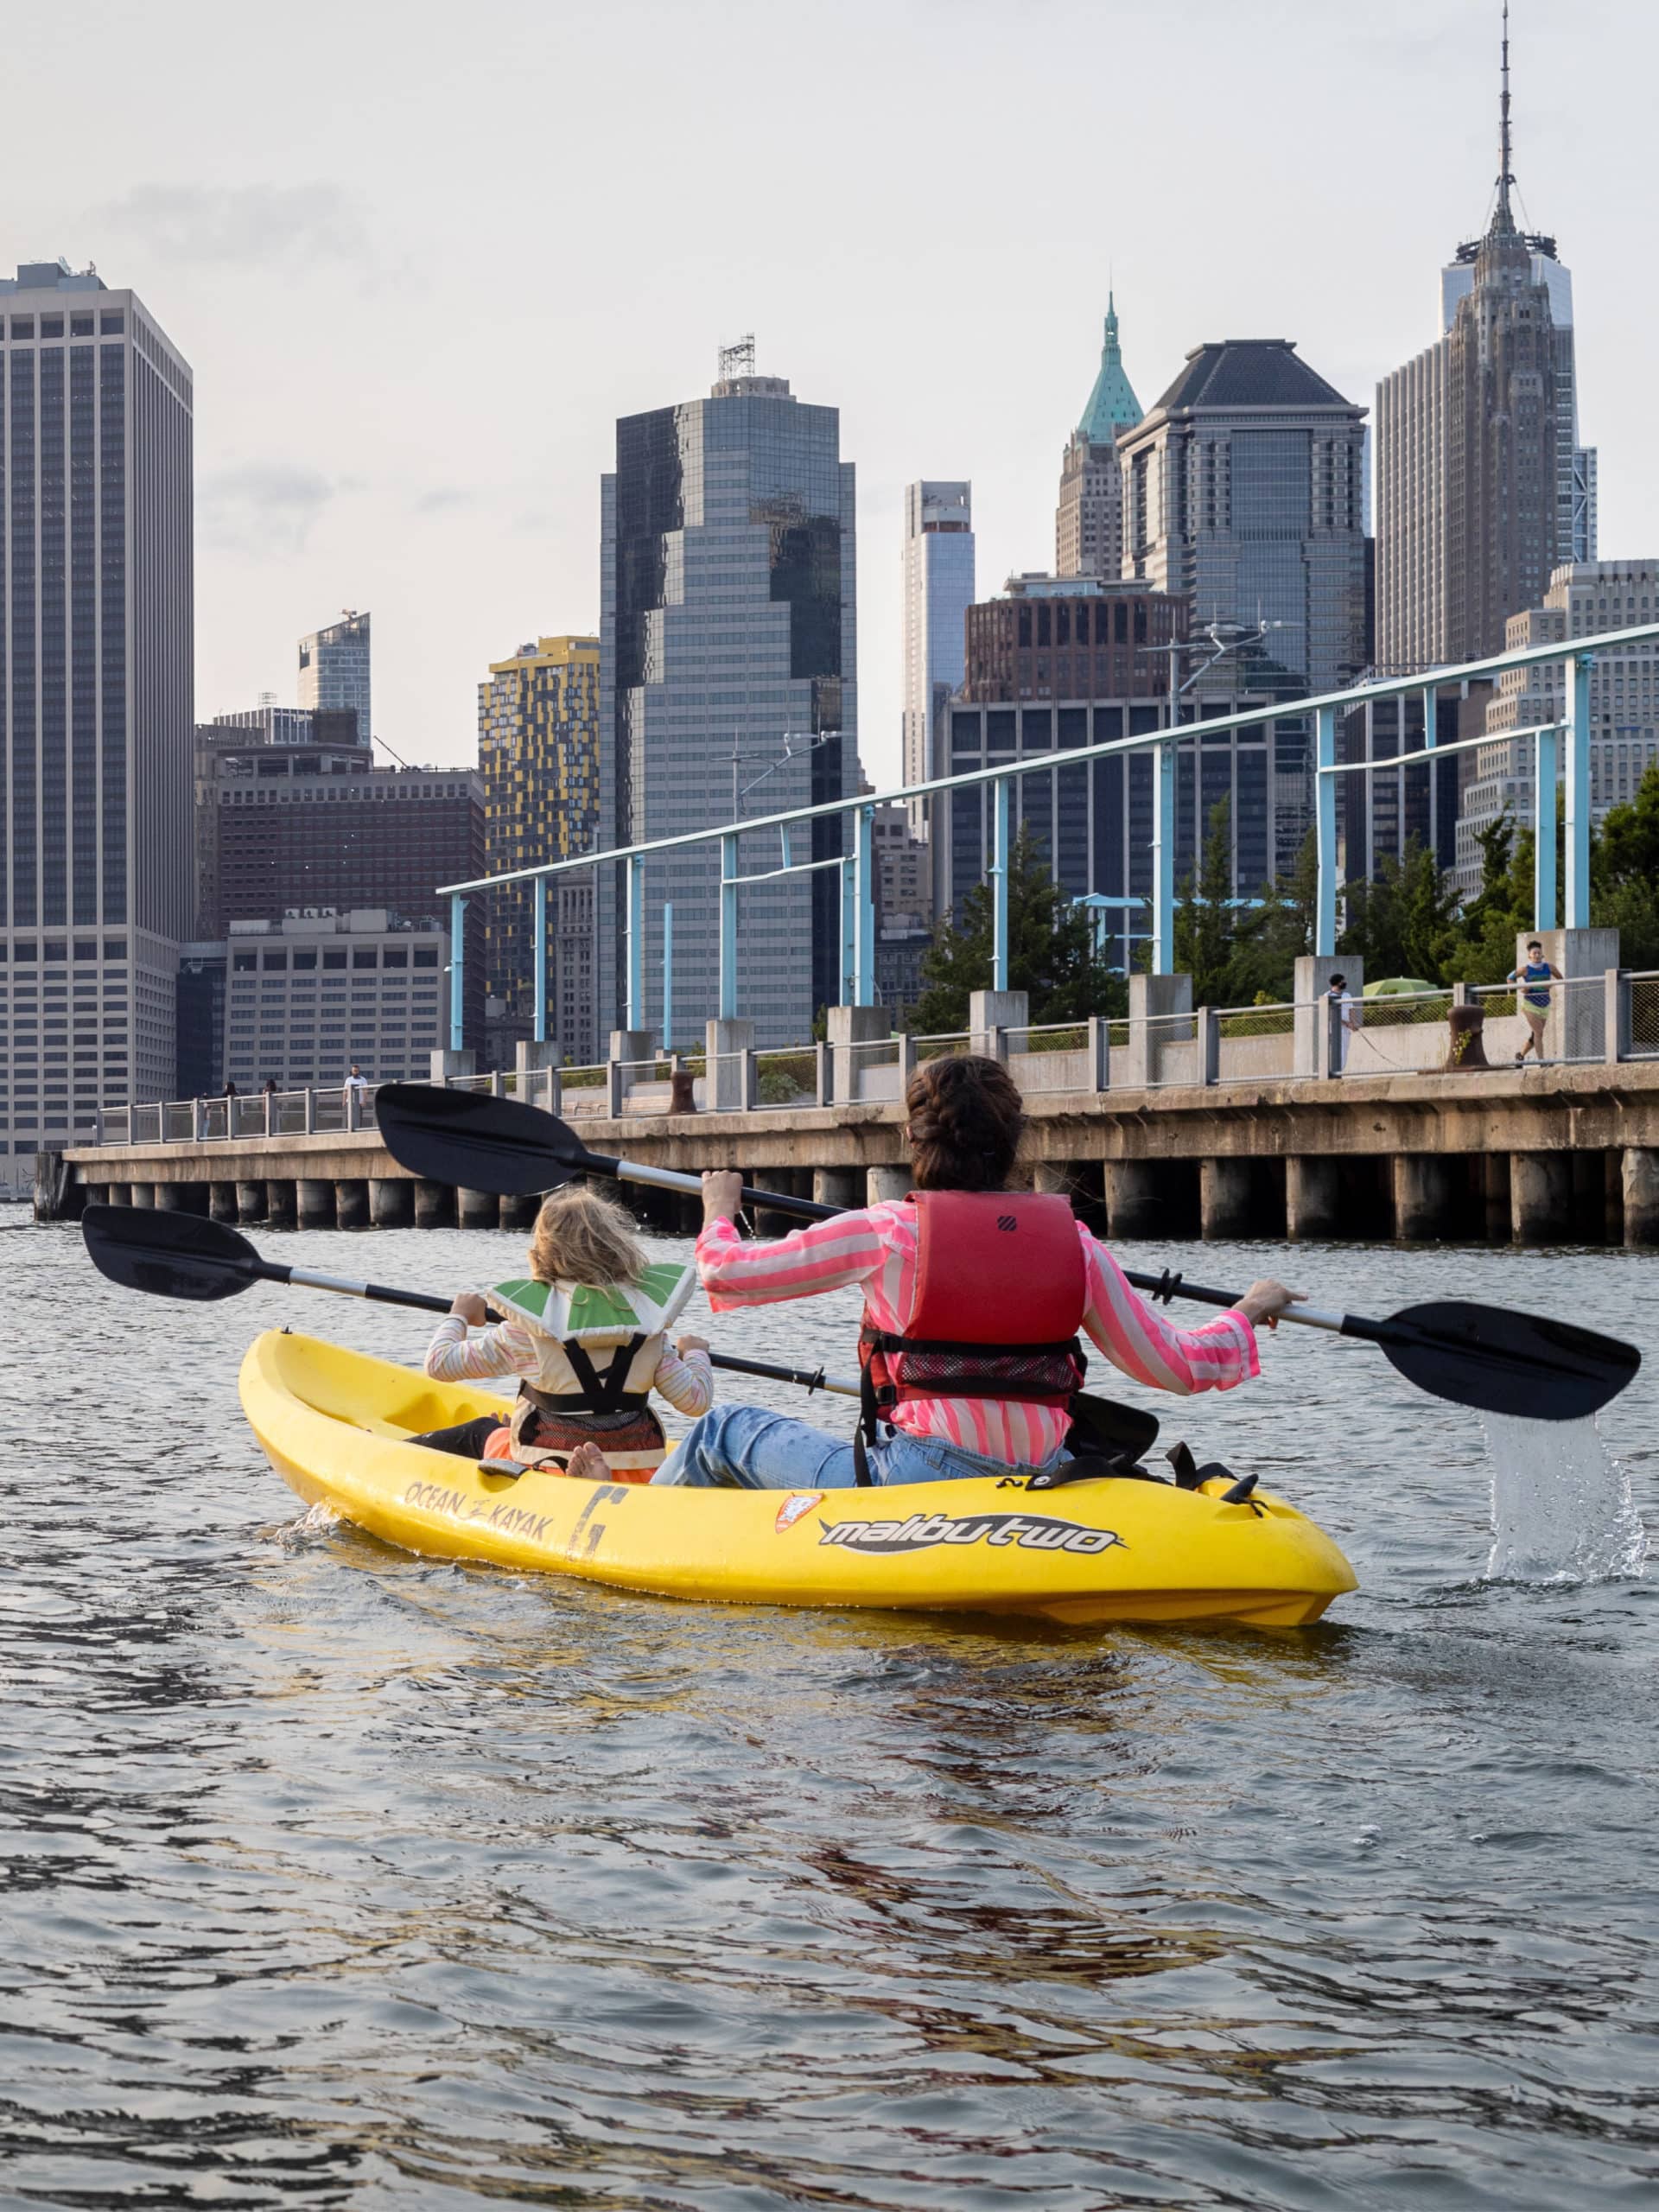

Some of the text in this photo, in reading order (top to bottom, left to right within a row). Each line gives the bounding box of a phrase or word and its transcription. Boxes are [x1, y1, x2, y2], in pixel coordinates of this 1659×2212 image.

[404, 1481, 553, 1541] OCEAN KAYAK
[821, 1515, 1117, 1553] malibu two
